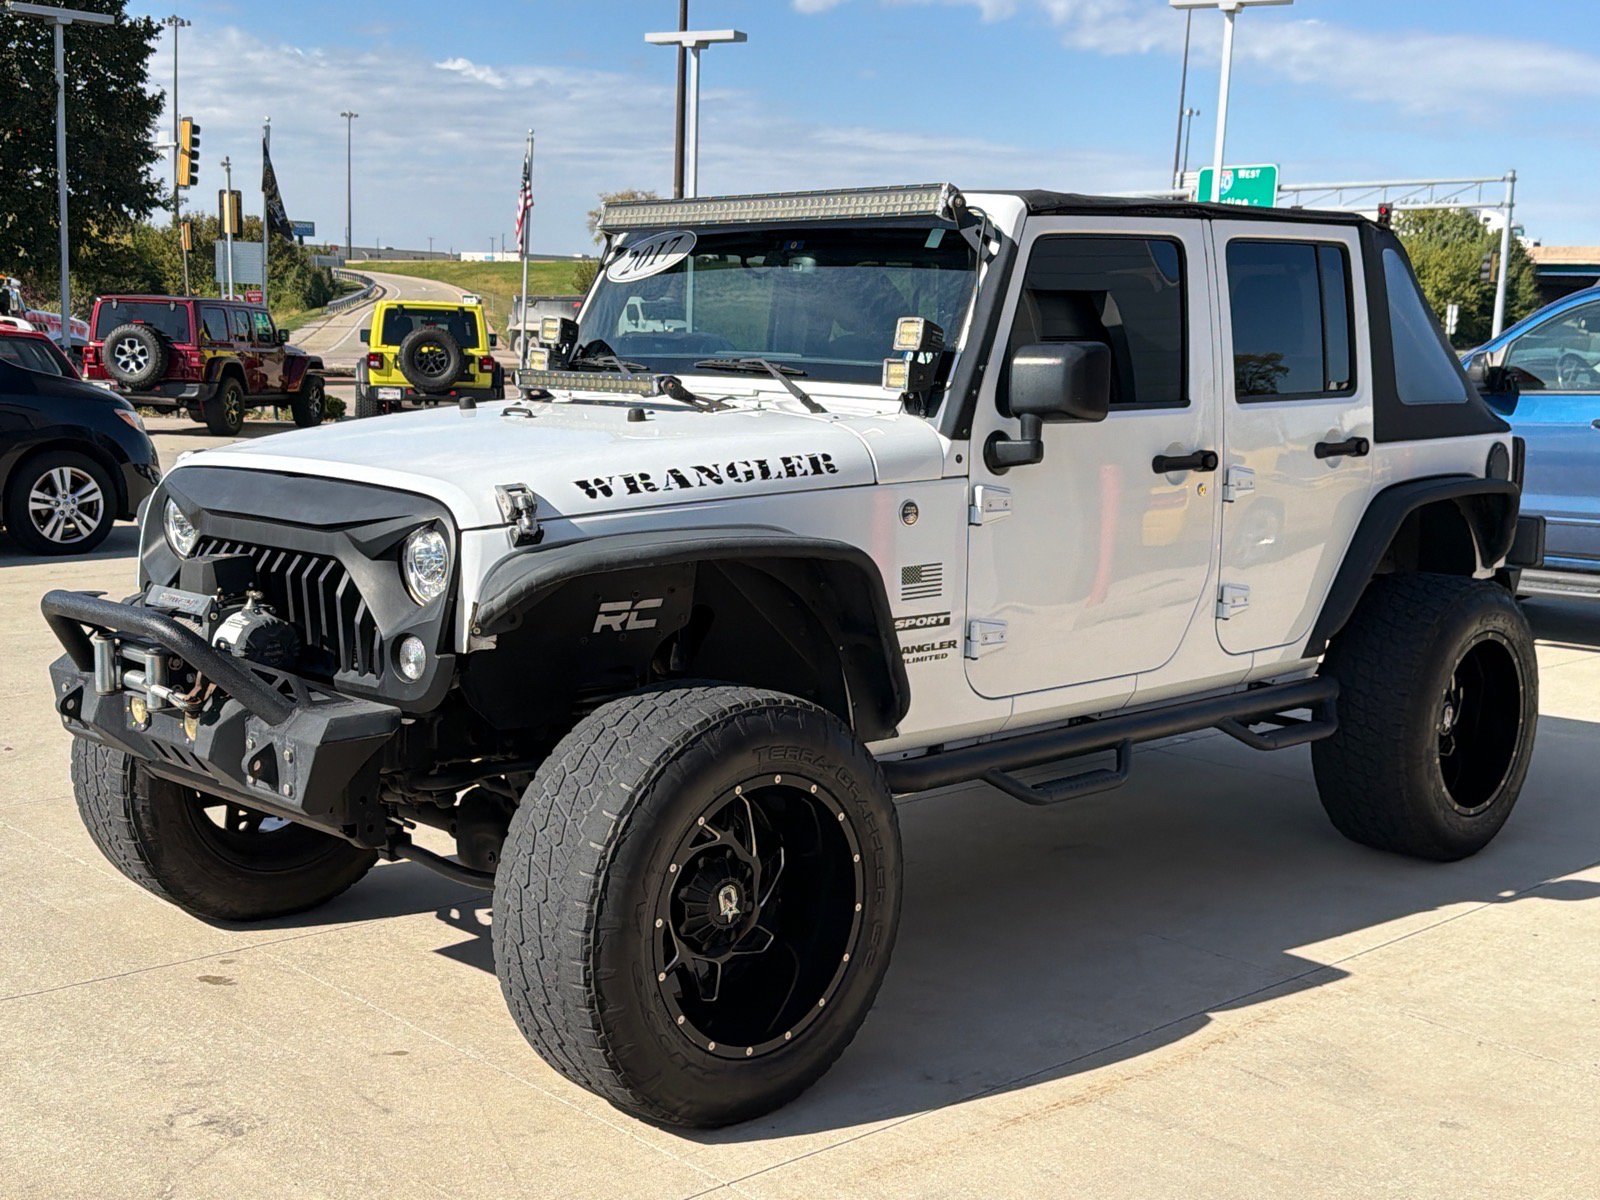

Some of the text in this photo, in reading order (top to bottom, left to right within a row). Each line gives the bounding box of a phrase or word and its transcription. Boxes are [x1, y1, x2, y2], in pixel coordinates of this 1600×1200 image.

[1237, 169, 1261, 179] WEST
[619, 235, 684, 277] 2017
[572, 452, 839, 499] WRANGLER
[592, 598, 664, 633] RC
[894, 614, 951, 630] SPORT
[901, 639, 957, 655] ANGLER
[904, 652, 949, 665] LIMITED
